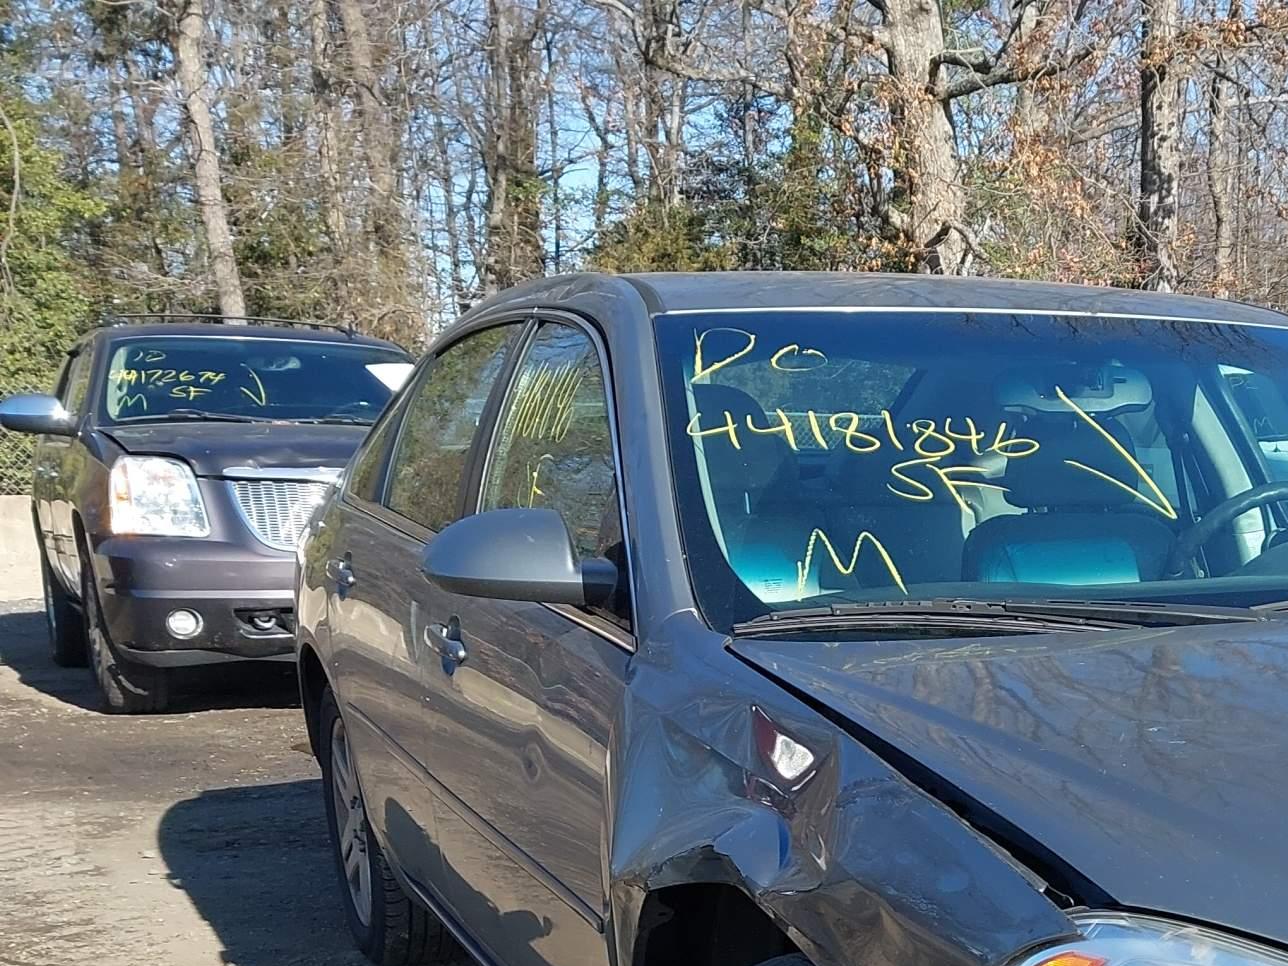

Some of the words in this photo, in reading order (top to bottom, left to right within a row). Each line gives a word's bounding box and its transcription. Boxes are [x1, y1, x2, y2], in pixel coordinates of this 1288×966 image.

[115, 393, 148, 417] M
[169, 386, 213, 401] SF
[686, 408, 1040, 456] 44181846
[887, 456, 1011, 517] SF
[797, 527, 909, 602] M
